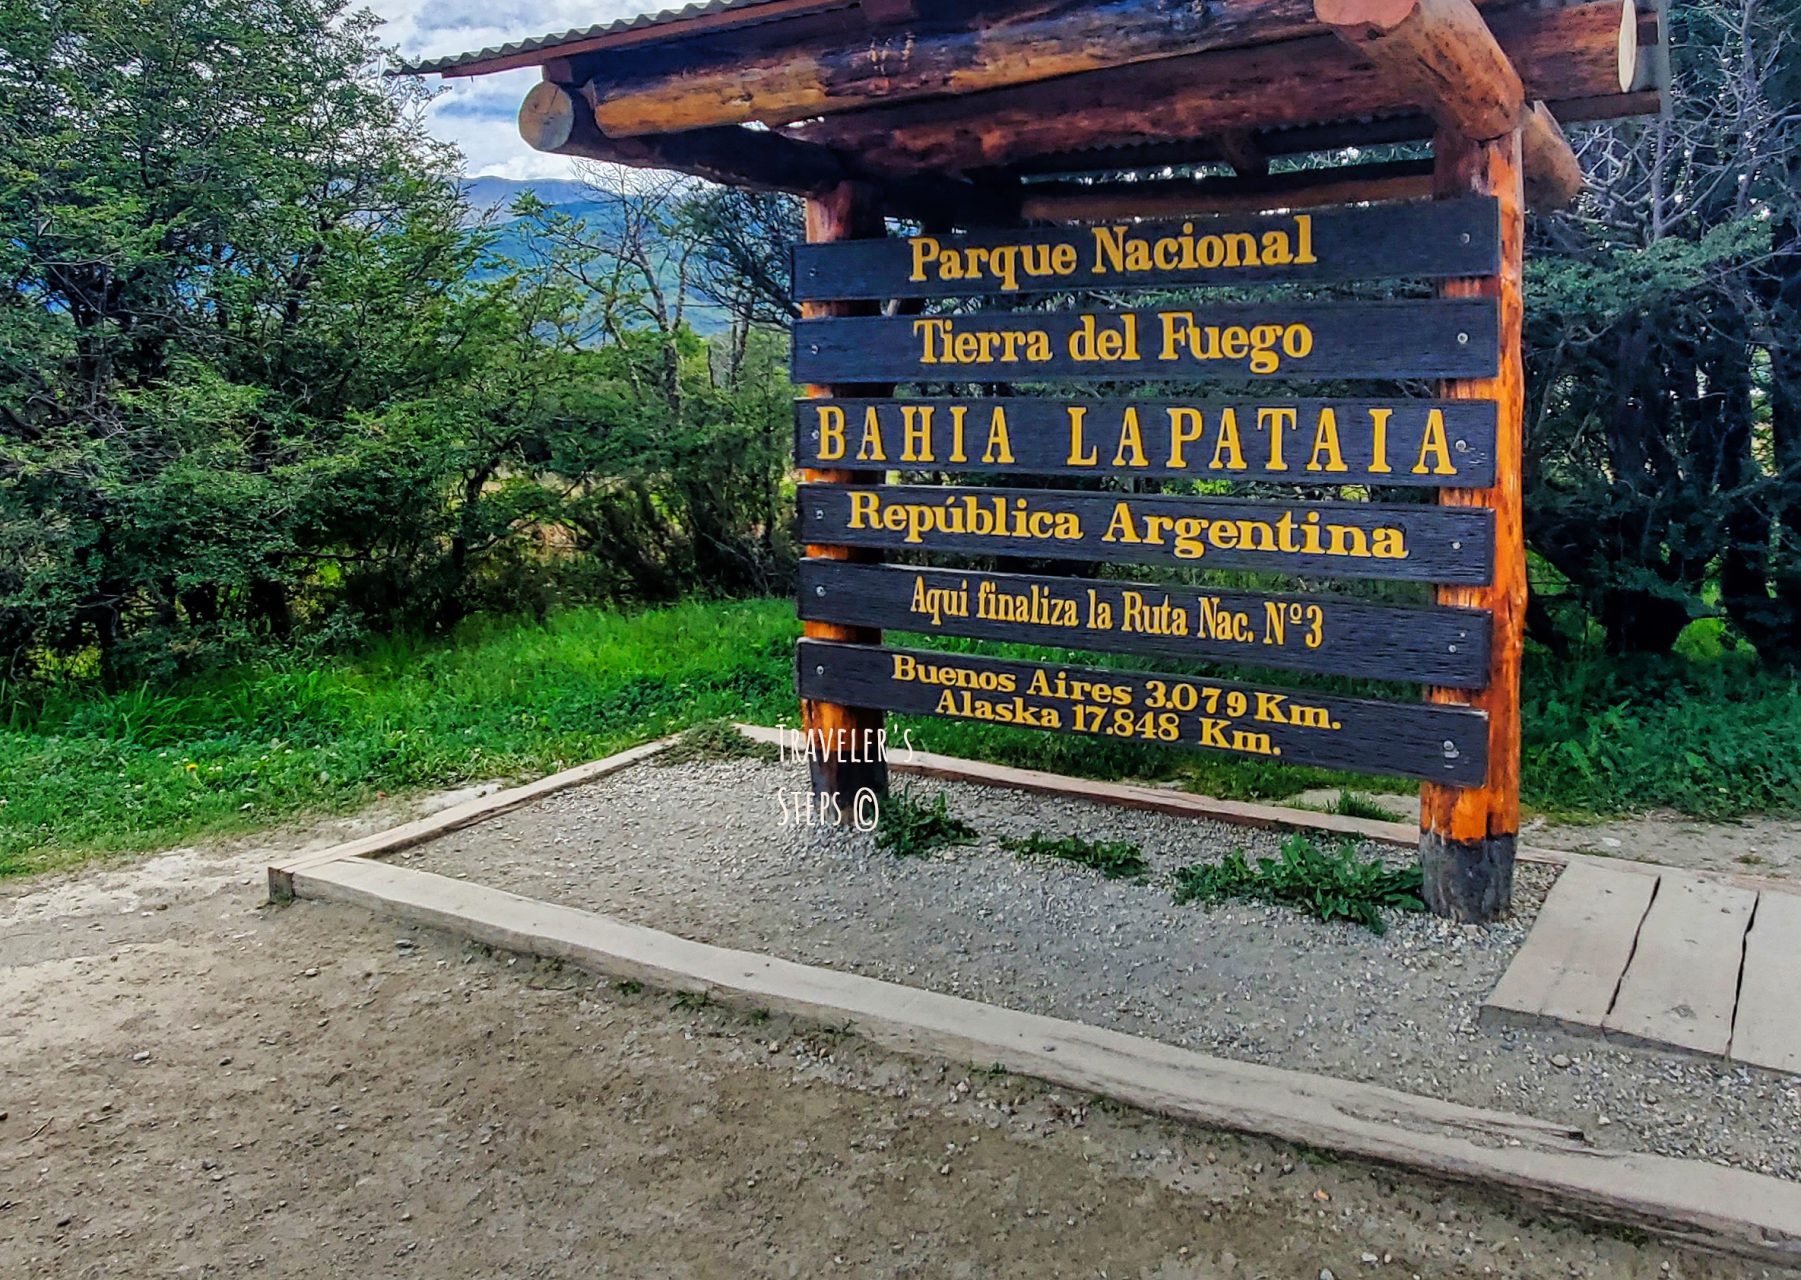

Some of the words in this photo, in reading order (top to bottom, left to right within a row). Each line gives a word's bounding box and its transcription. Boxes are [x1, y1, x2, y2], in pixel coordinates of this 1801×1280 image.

[908, 236, 1077, 291] Parque
[1092, 214, 1315, 274] Nacional
[914, 318, 1052, 365] Tierra
[1067, 312, 1142, 362] del
[1159, 310, 1314, 375] Fuego
[818, 406, 1014, 465] BAHIA
[1065, 406, 1456, 476] LAPATAIA
[846, 491, 1083, 544] República
[1102, 501, 1407, 559] Argentina
[909, 575, 969, 627] Aqui
[976, 580, 1079, 631] finaliza
[1087, 587, 1114, 631] la
[1120, 590, 1190, 637] Ruta
[1197, 596, 1256, 643] Nac.
[891, 654, 1017, 692] Buenos
[1026, 669, 1134, 706] Aires
[1144, 680, 1249, 718] 3.079
[1253, 691, 1343, 731] Km.
[934, 689, 1062, 729] Alaska
[1071, 703, 1180, 742] 17.848
[1198, 716, 1283, 756] Km.
